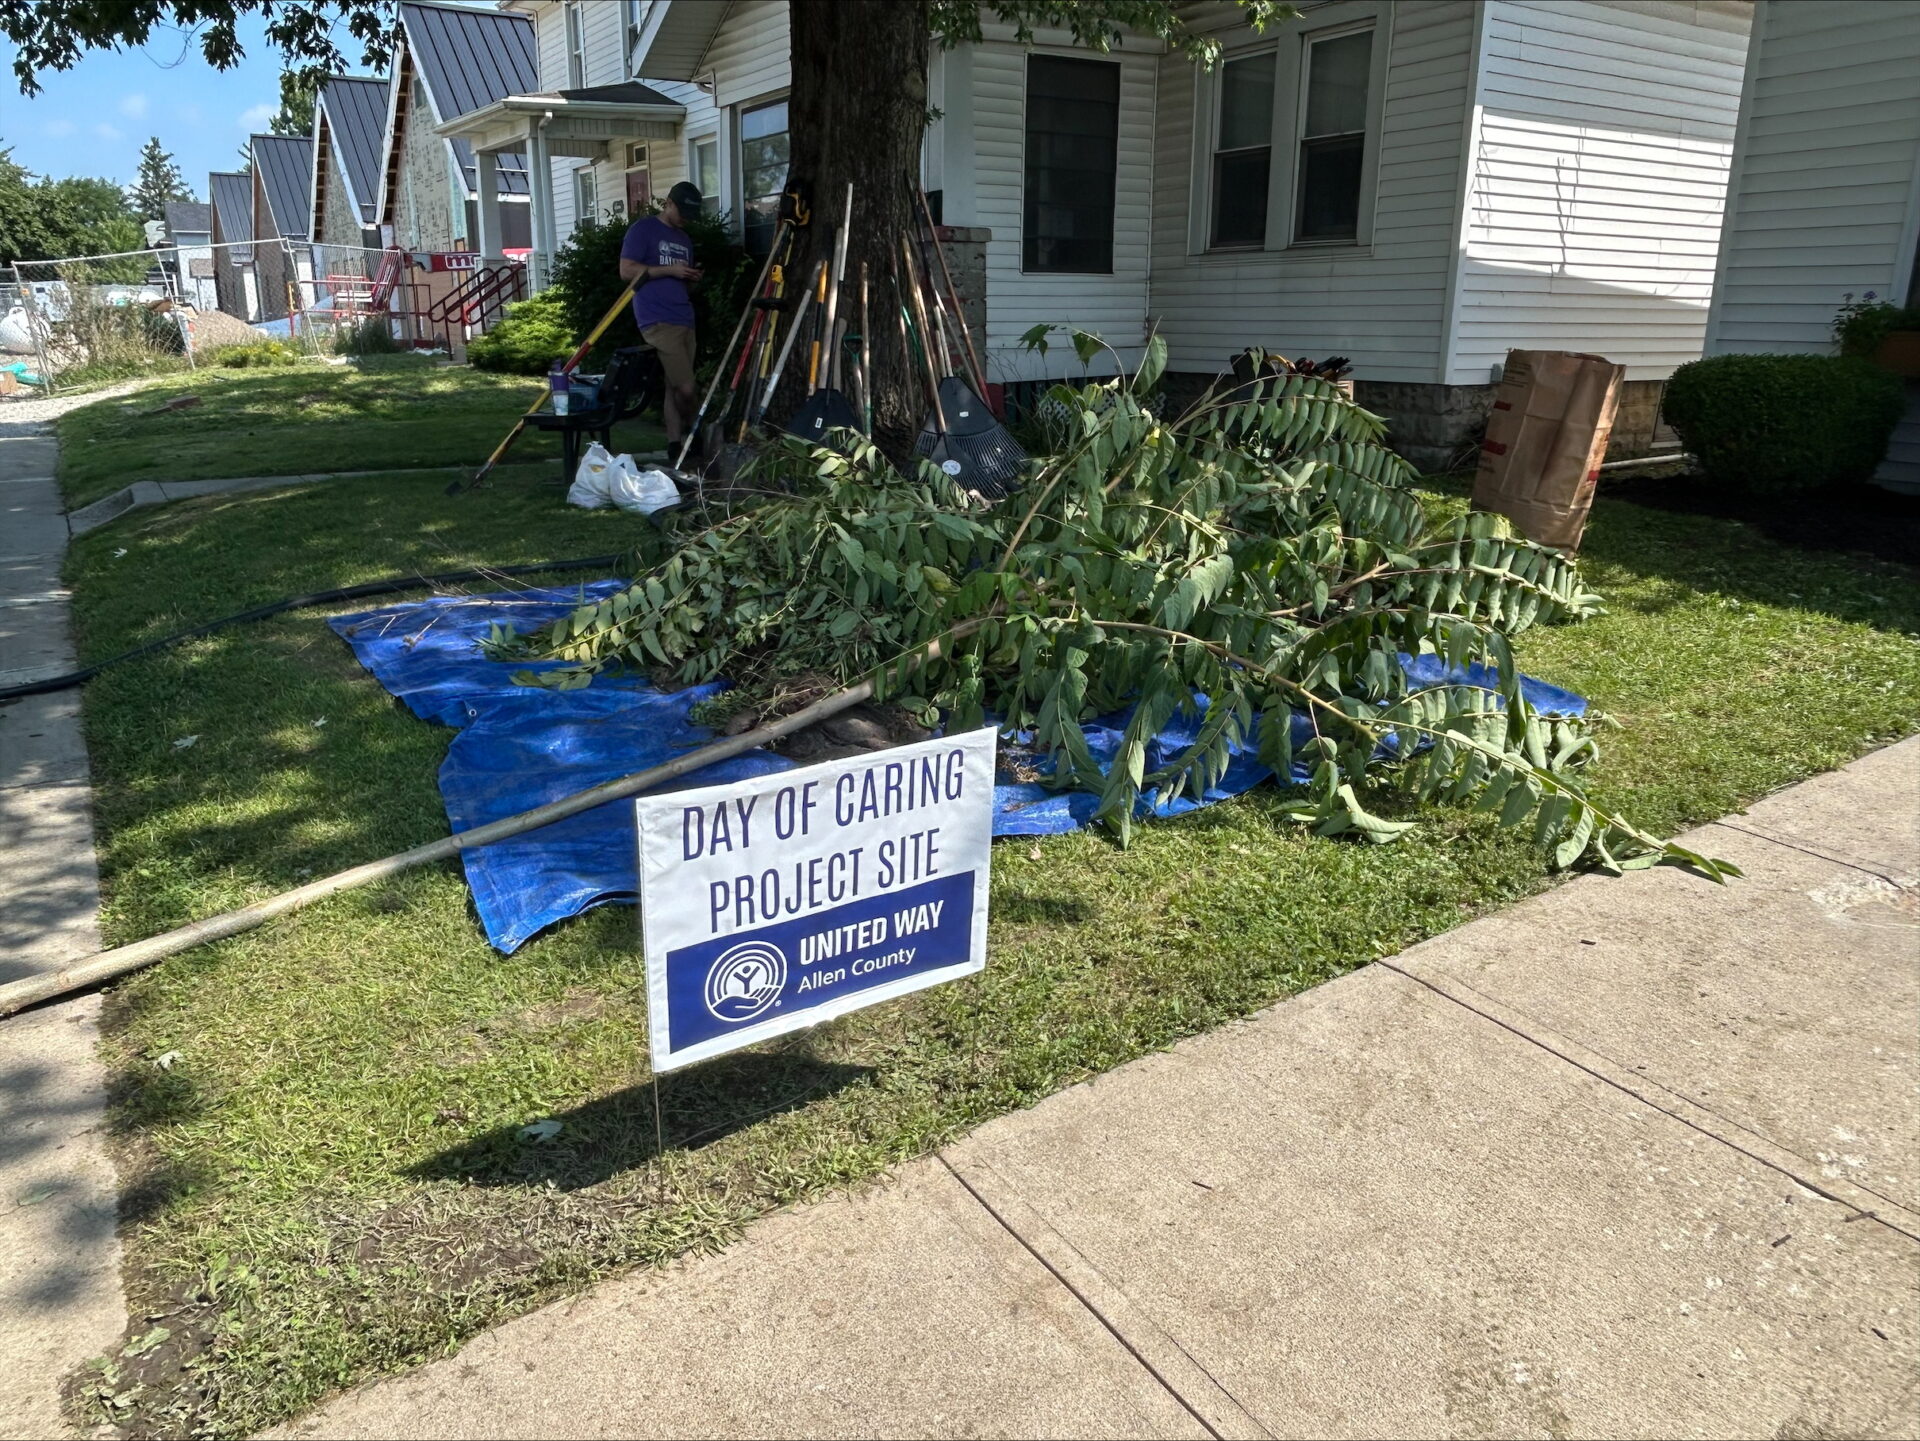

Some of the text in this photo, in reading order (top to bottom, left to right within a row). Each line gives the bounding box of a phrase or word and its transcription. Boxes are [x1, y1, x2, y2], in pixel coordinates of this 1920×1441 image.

[682, 749, 964, 861] DAY OF CARING
[709, 828, 940, 933] PROJECT SITE
[797, 947, 917, 994] Allen County
[800, 900, 945, 966] UNITED WAY
